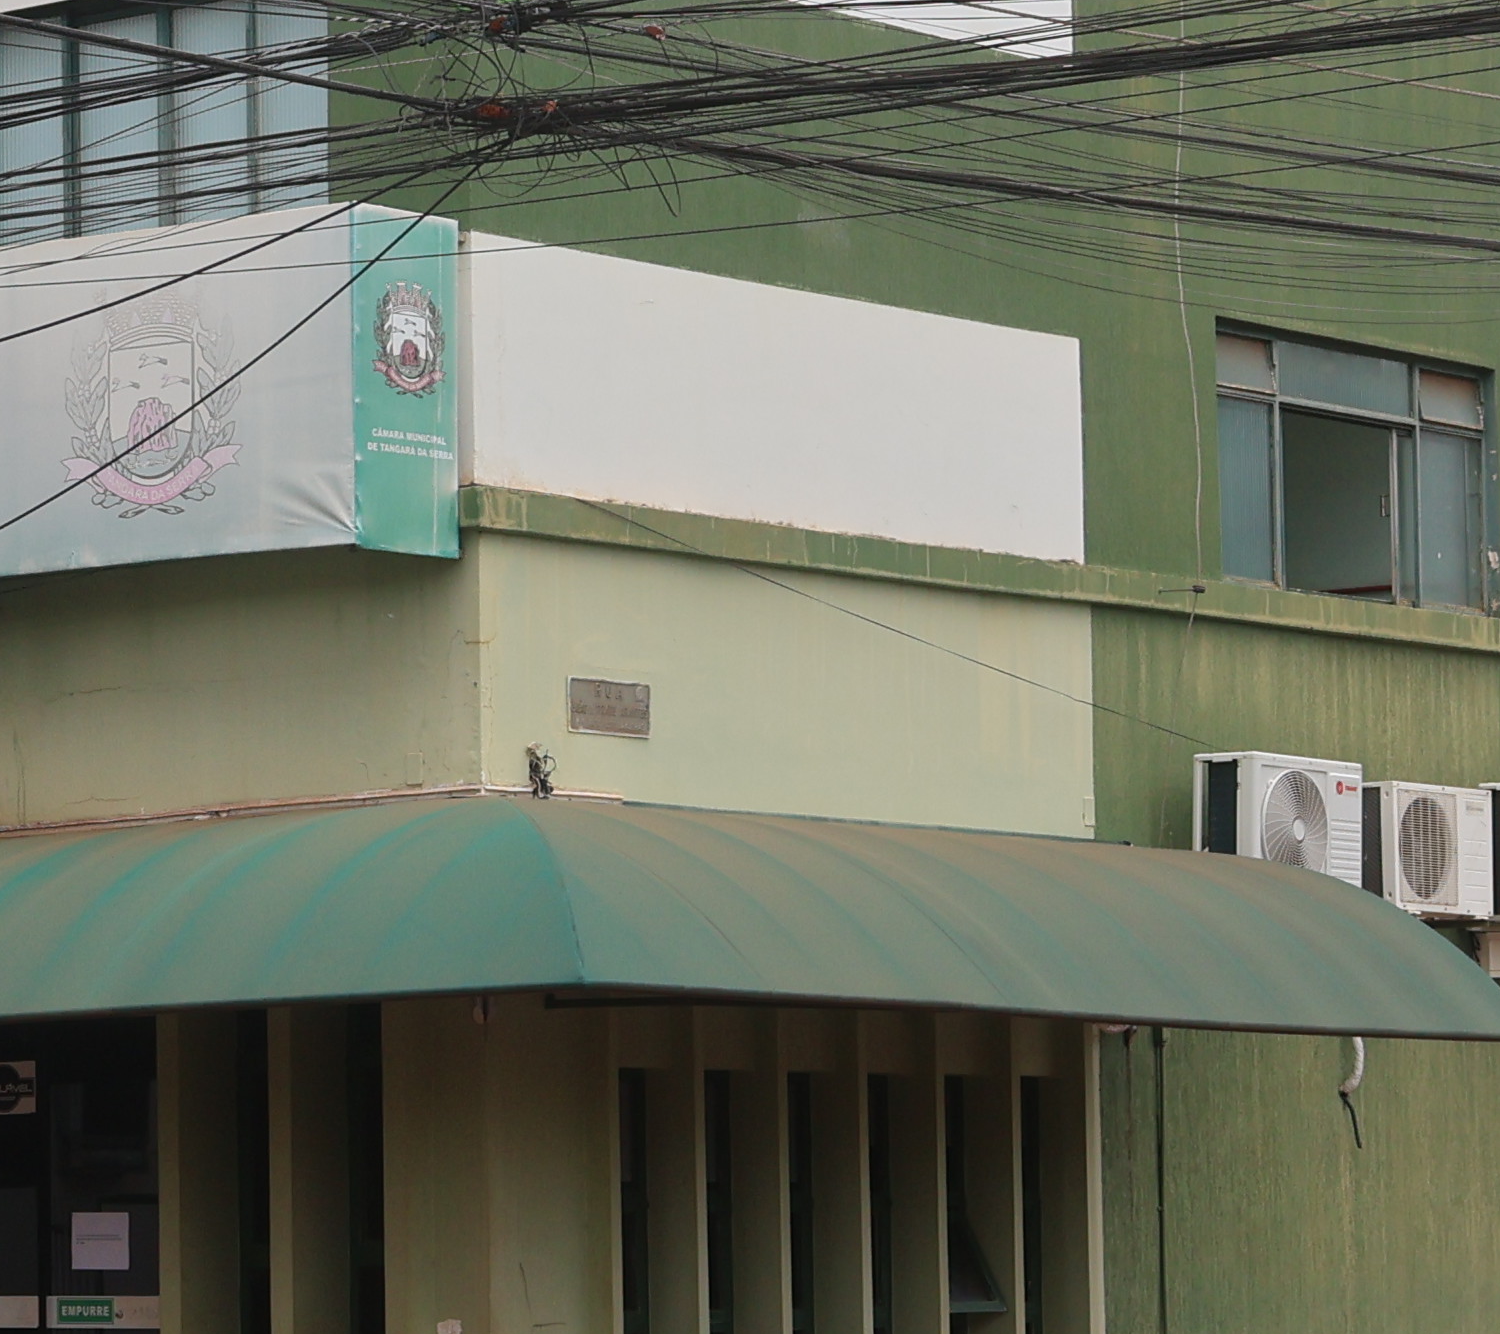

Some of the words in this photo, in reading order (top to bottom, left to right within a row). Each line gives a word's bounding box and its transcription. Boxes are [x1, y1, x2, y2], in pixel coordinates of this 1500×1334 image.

[372, 427, 405, 440] CÂMARA
[406, 432, 447, 446] MUNICIPAL
[367, 441, 379, 451] DE
[380, 442, 416, 456] TANGARÁ
[417, 448, 428, 457] DA
[429, 449, 455, 460] SERRA
[61, 1305, 110, 1317] EMPURRE
